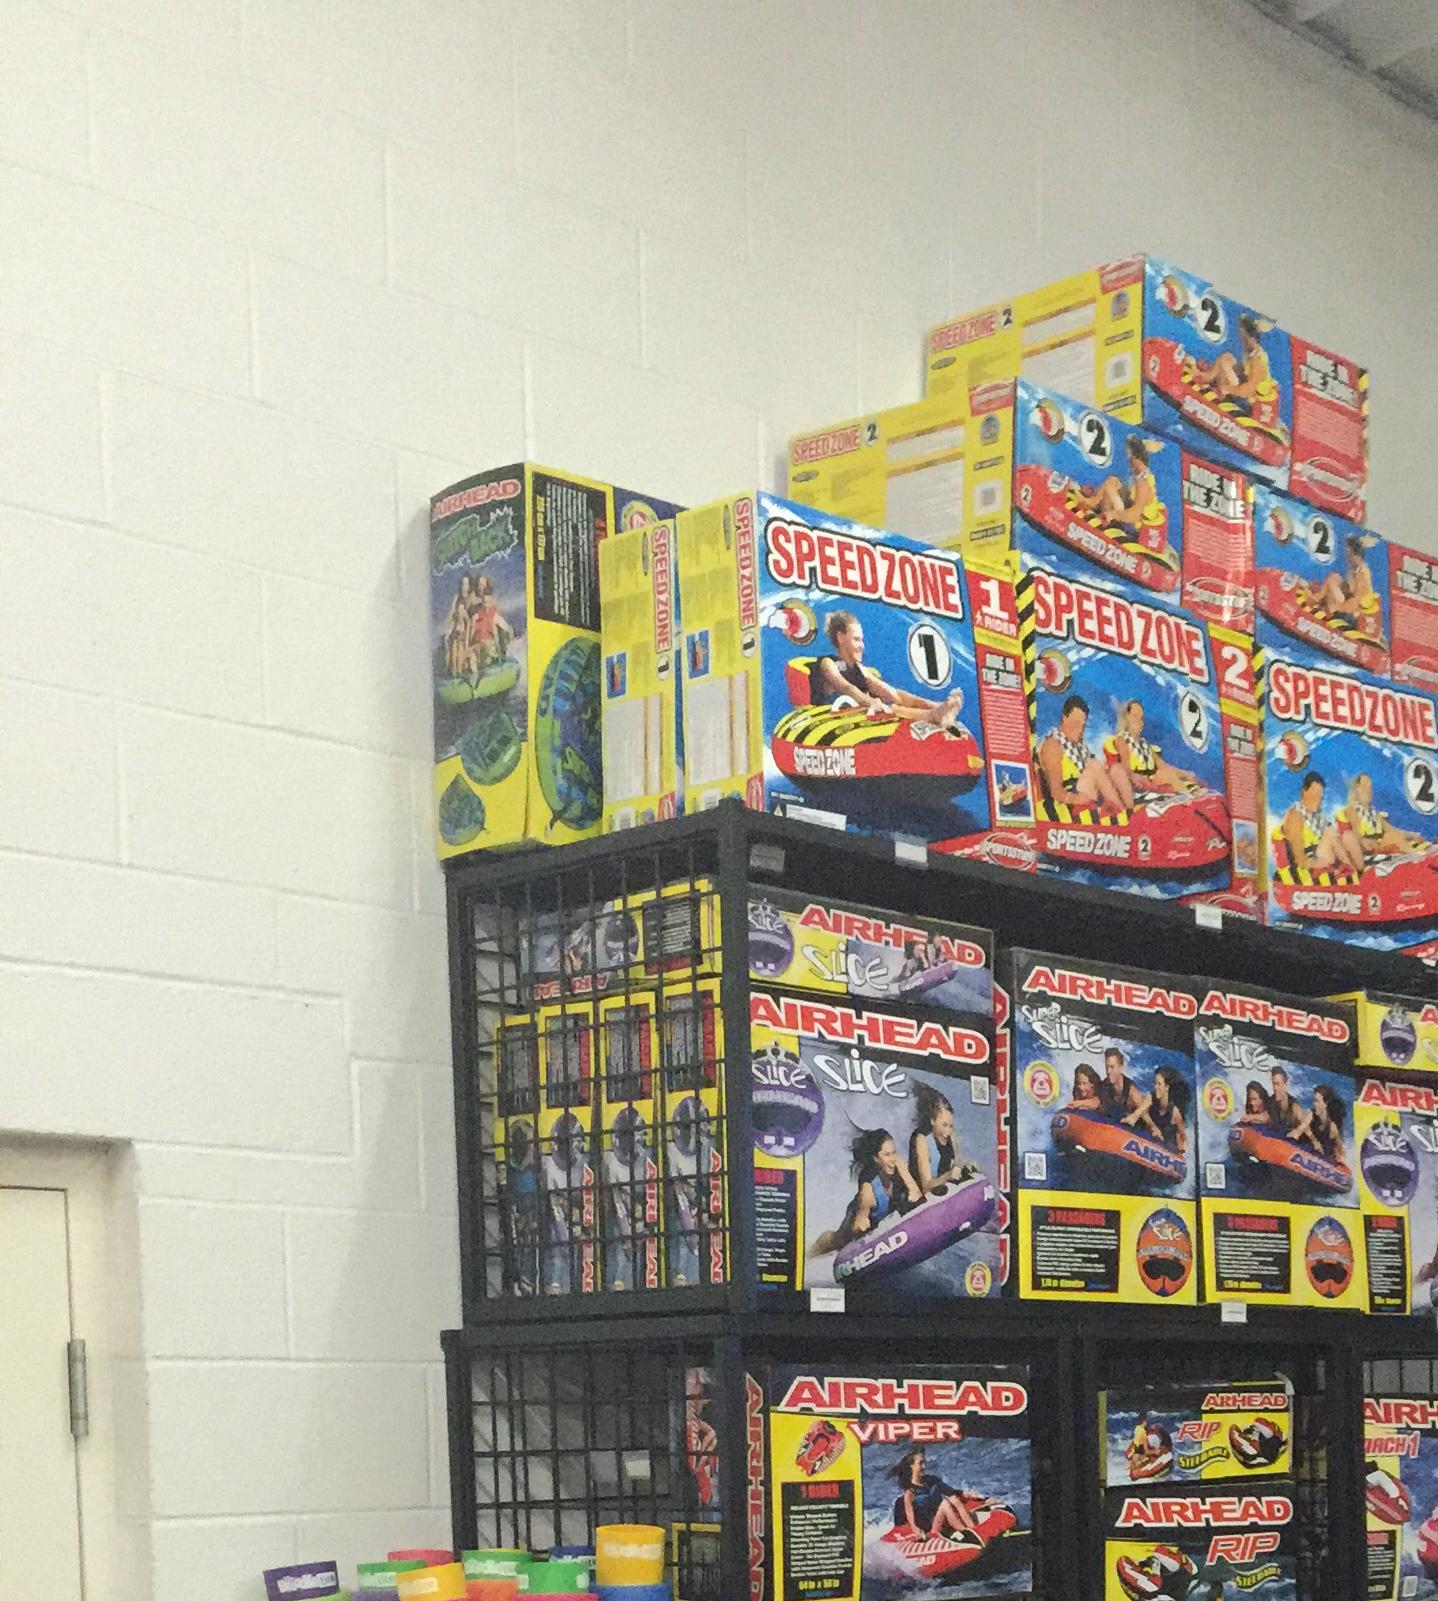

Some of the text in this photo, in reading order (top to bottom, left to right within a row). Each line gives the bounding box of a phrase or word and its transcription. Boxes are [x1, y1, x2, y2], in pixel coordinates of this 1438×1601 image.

[1202, 299, 1222, 337] 2
[1086, 418, 1107, 458] 2
[1312, 521, 1331, 557] 2
[981, 583, 1009, 618] 1
[922, 634, 940, 681] 1
[1219, 646, 1252, 689] 2
[1187, 697, 1203, 744] 2
[1413, 764, 1434, 803] 2
[799, 903, 987, 969] AIRHEAD
[1022, 965, 1197, 1020] AIRHEAD
[1199, 991, 1351, 1043] AIRHEAD
[778, 1376, 1029, 1416] AIRHEAD
[1200, 1393, 1289, 1412] AIRHEAD
[847, 1419, 962, 1444] VIPER
[1114, 1495, 1294, 1528] AIRHEAD
[1205, 1531, 1281, 1567] RIP
